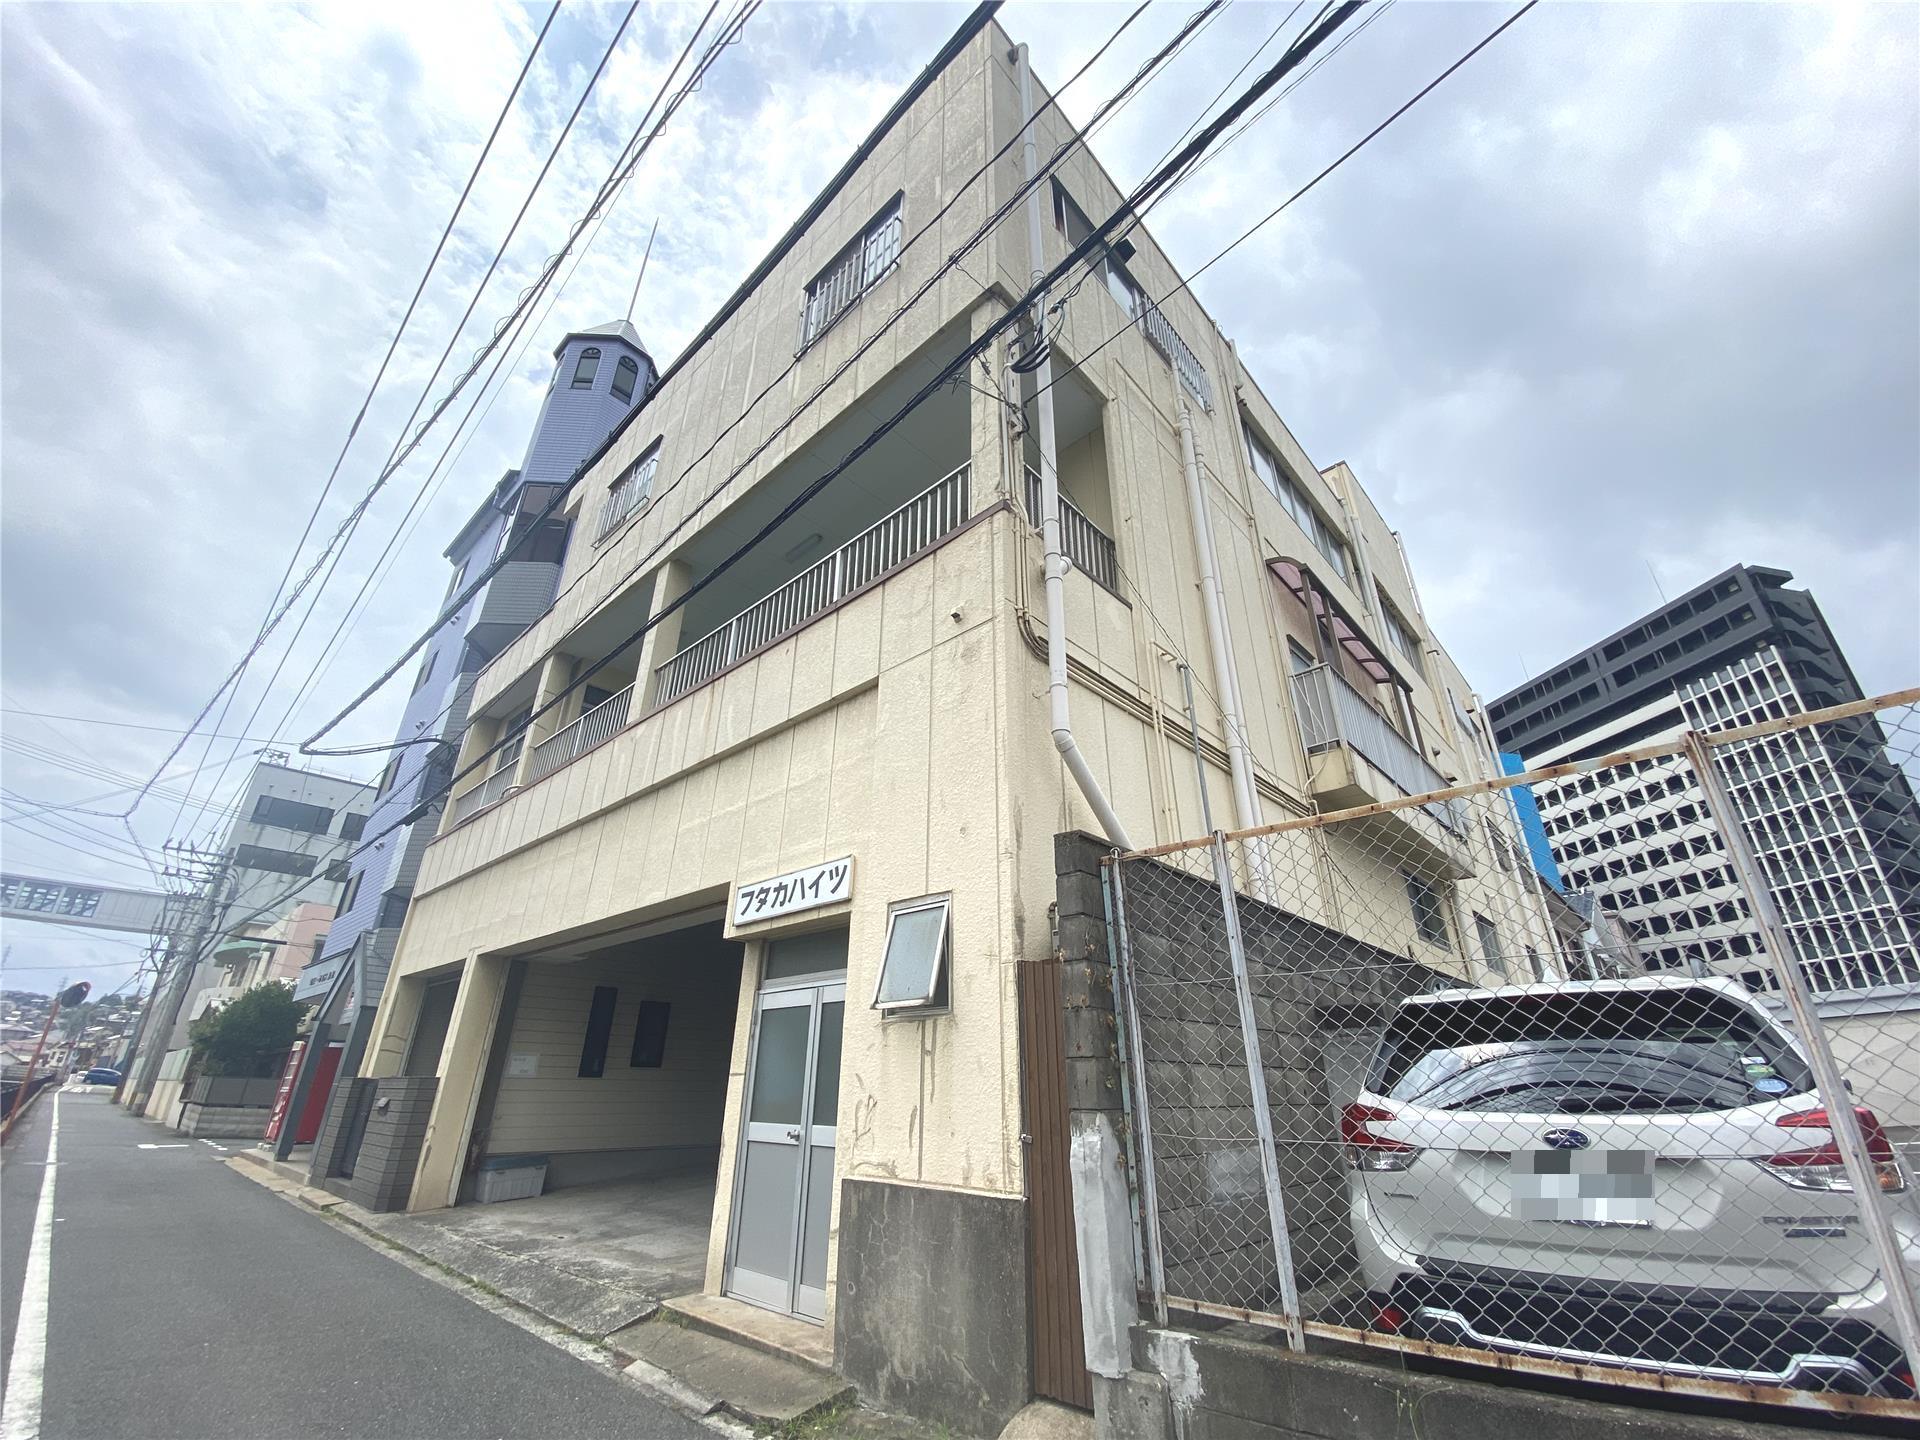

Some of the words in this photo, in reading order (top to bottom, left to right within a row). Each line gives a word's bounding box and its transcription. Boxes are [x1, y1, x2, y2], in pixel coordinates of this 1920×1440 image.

[740, 865, 848, 916] フタカハイツ
